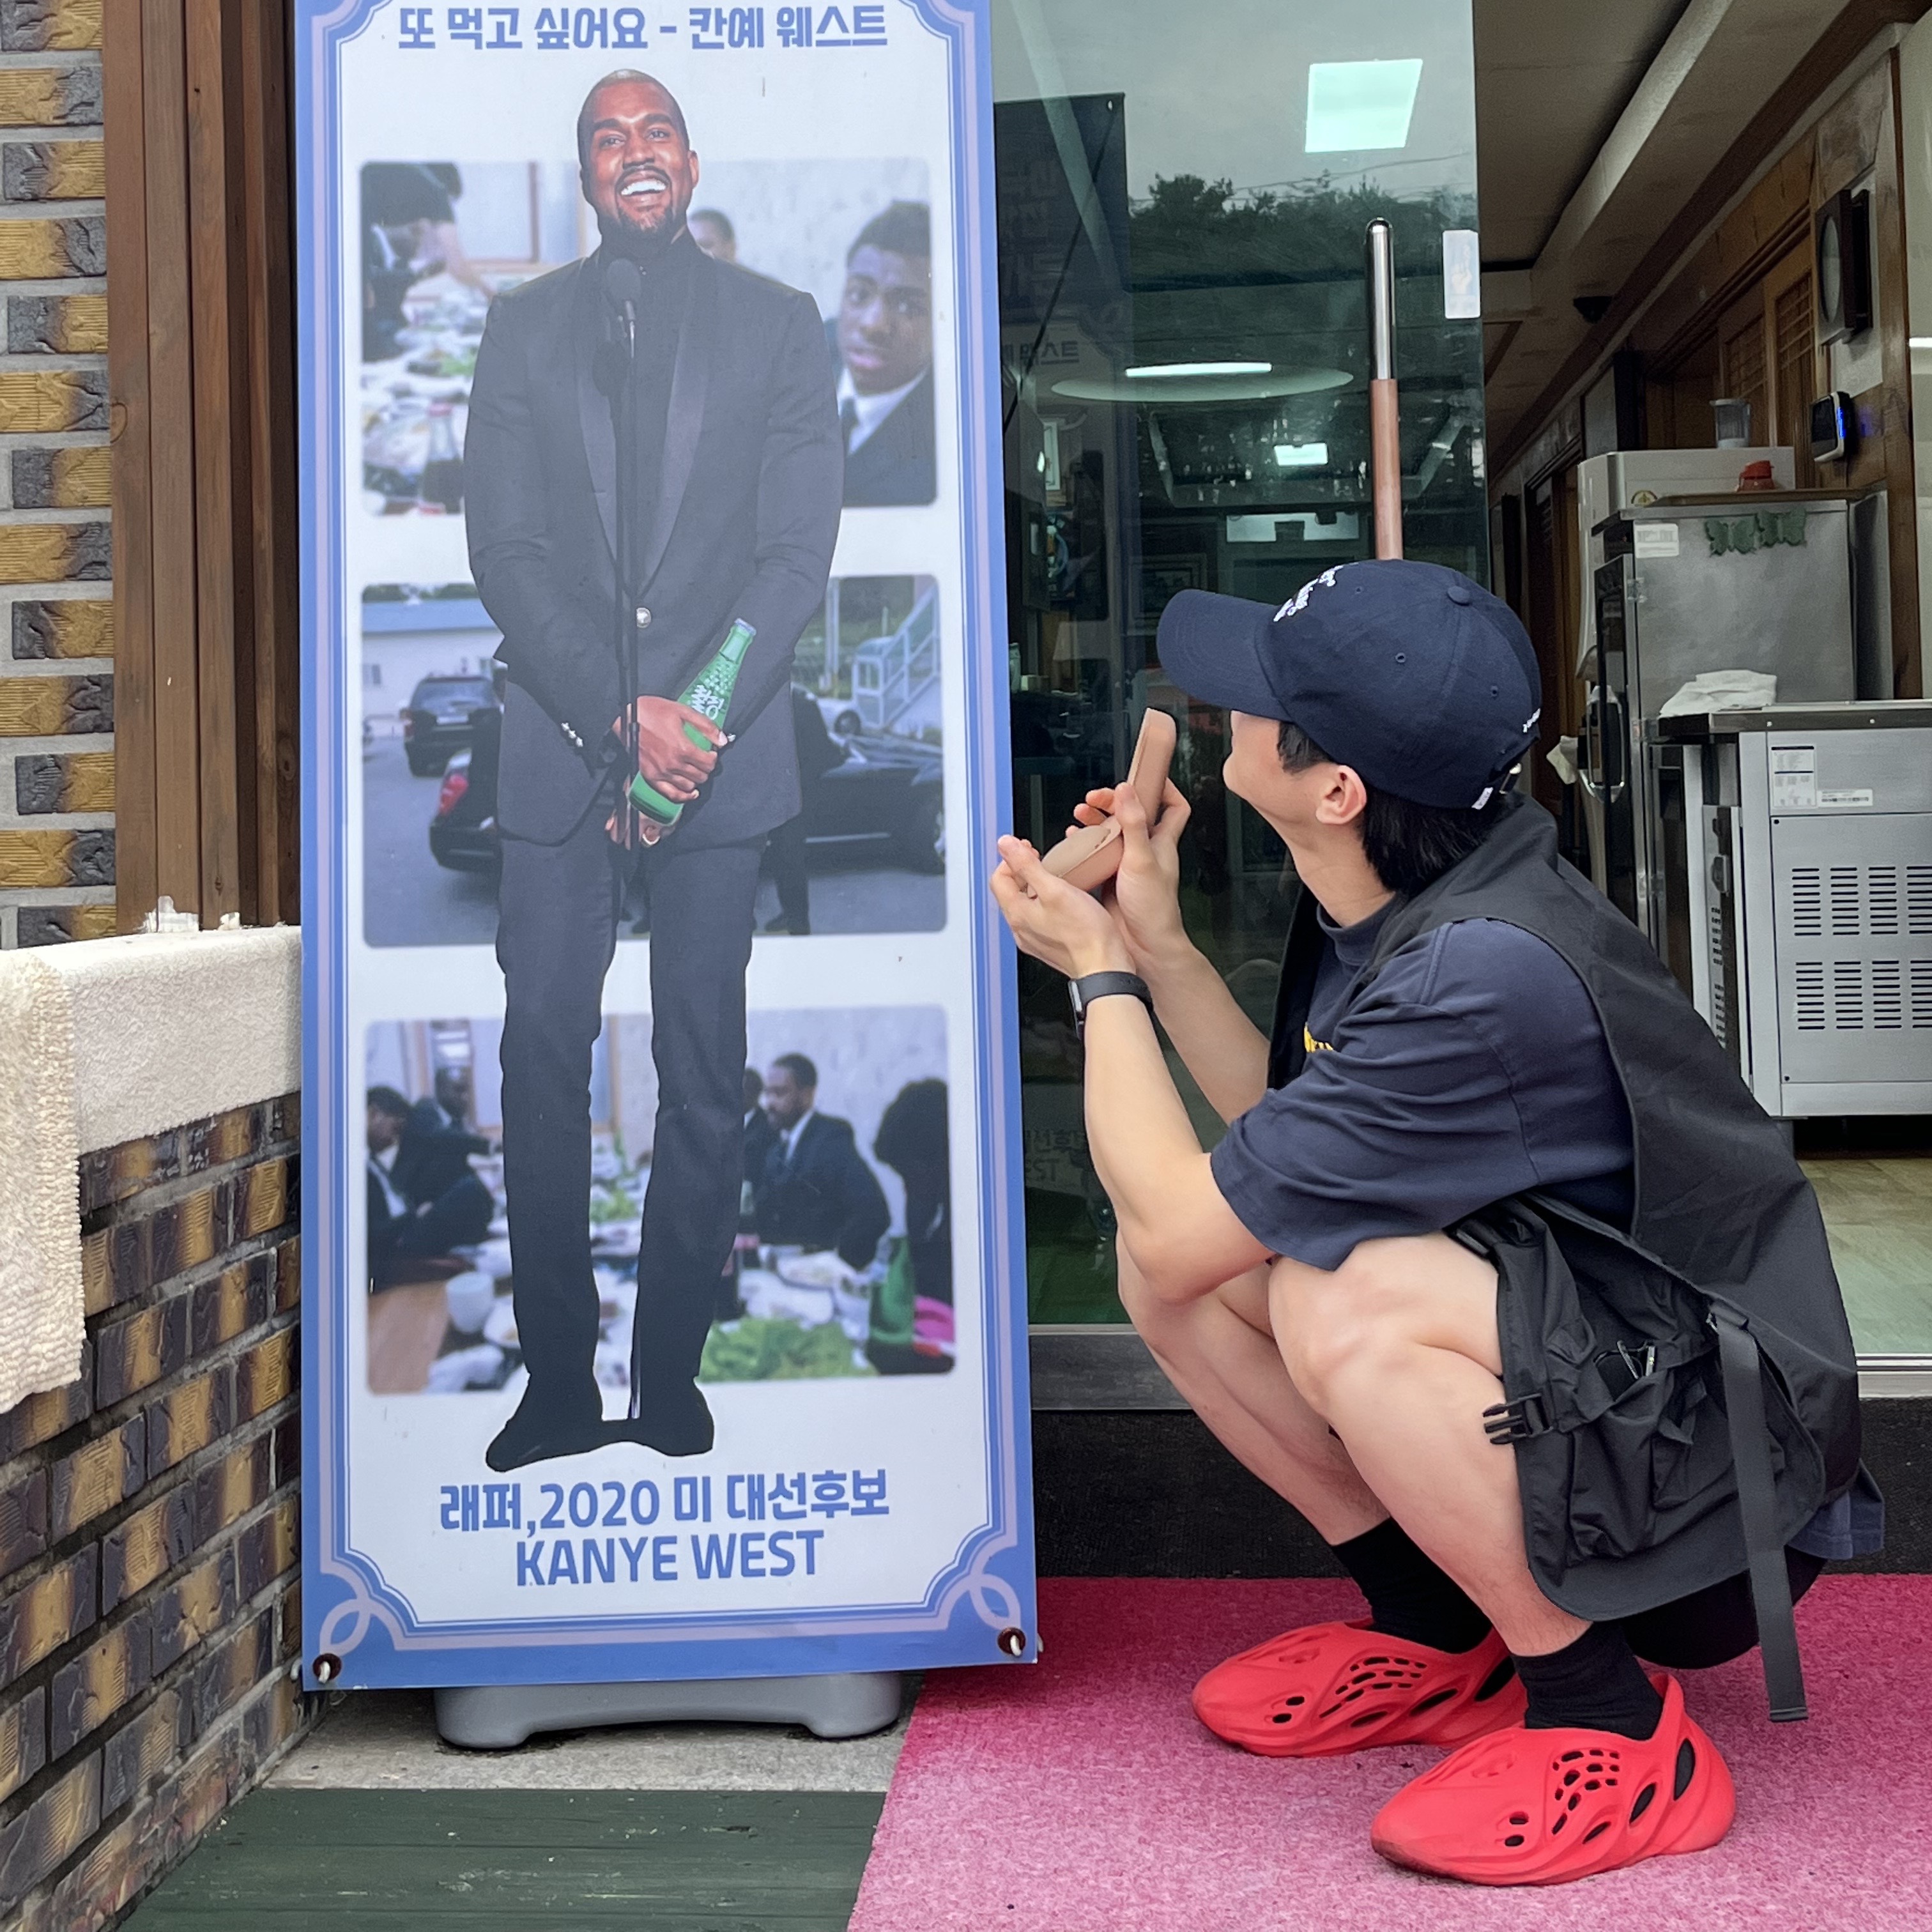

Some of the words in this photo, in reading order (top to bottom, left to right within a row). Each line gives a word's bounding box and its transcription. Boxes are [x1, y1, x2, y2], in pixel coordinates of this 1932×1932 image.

[398, 7, 436, 50] 또
[447, 6, 523, 50] 먹고
[534, 7, 648, 50] 싶어요
[659, 25, 678, 34] -
[689, 6, 765, 50] 칸예
[776, 4, 888, 48] 웨스트
[440, 1478, 662, 1537] 래퍼,2020
[673, 1475, 713, 1524] 미
[725, 1468, 890, 1522] 대선후보
[516, 1535, 679, 1588] KANYE
[690, 1529, 825, 1581] WEST
